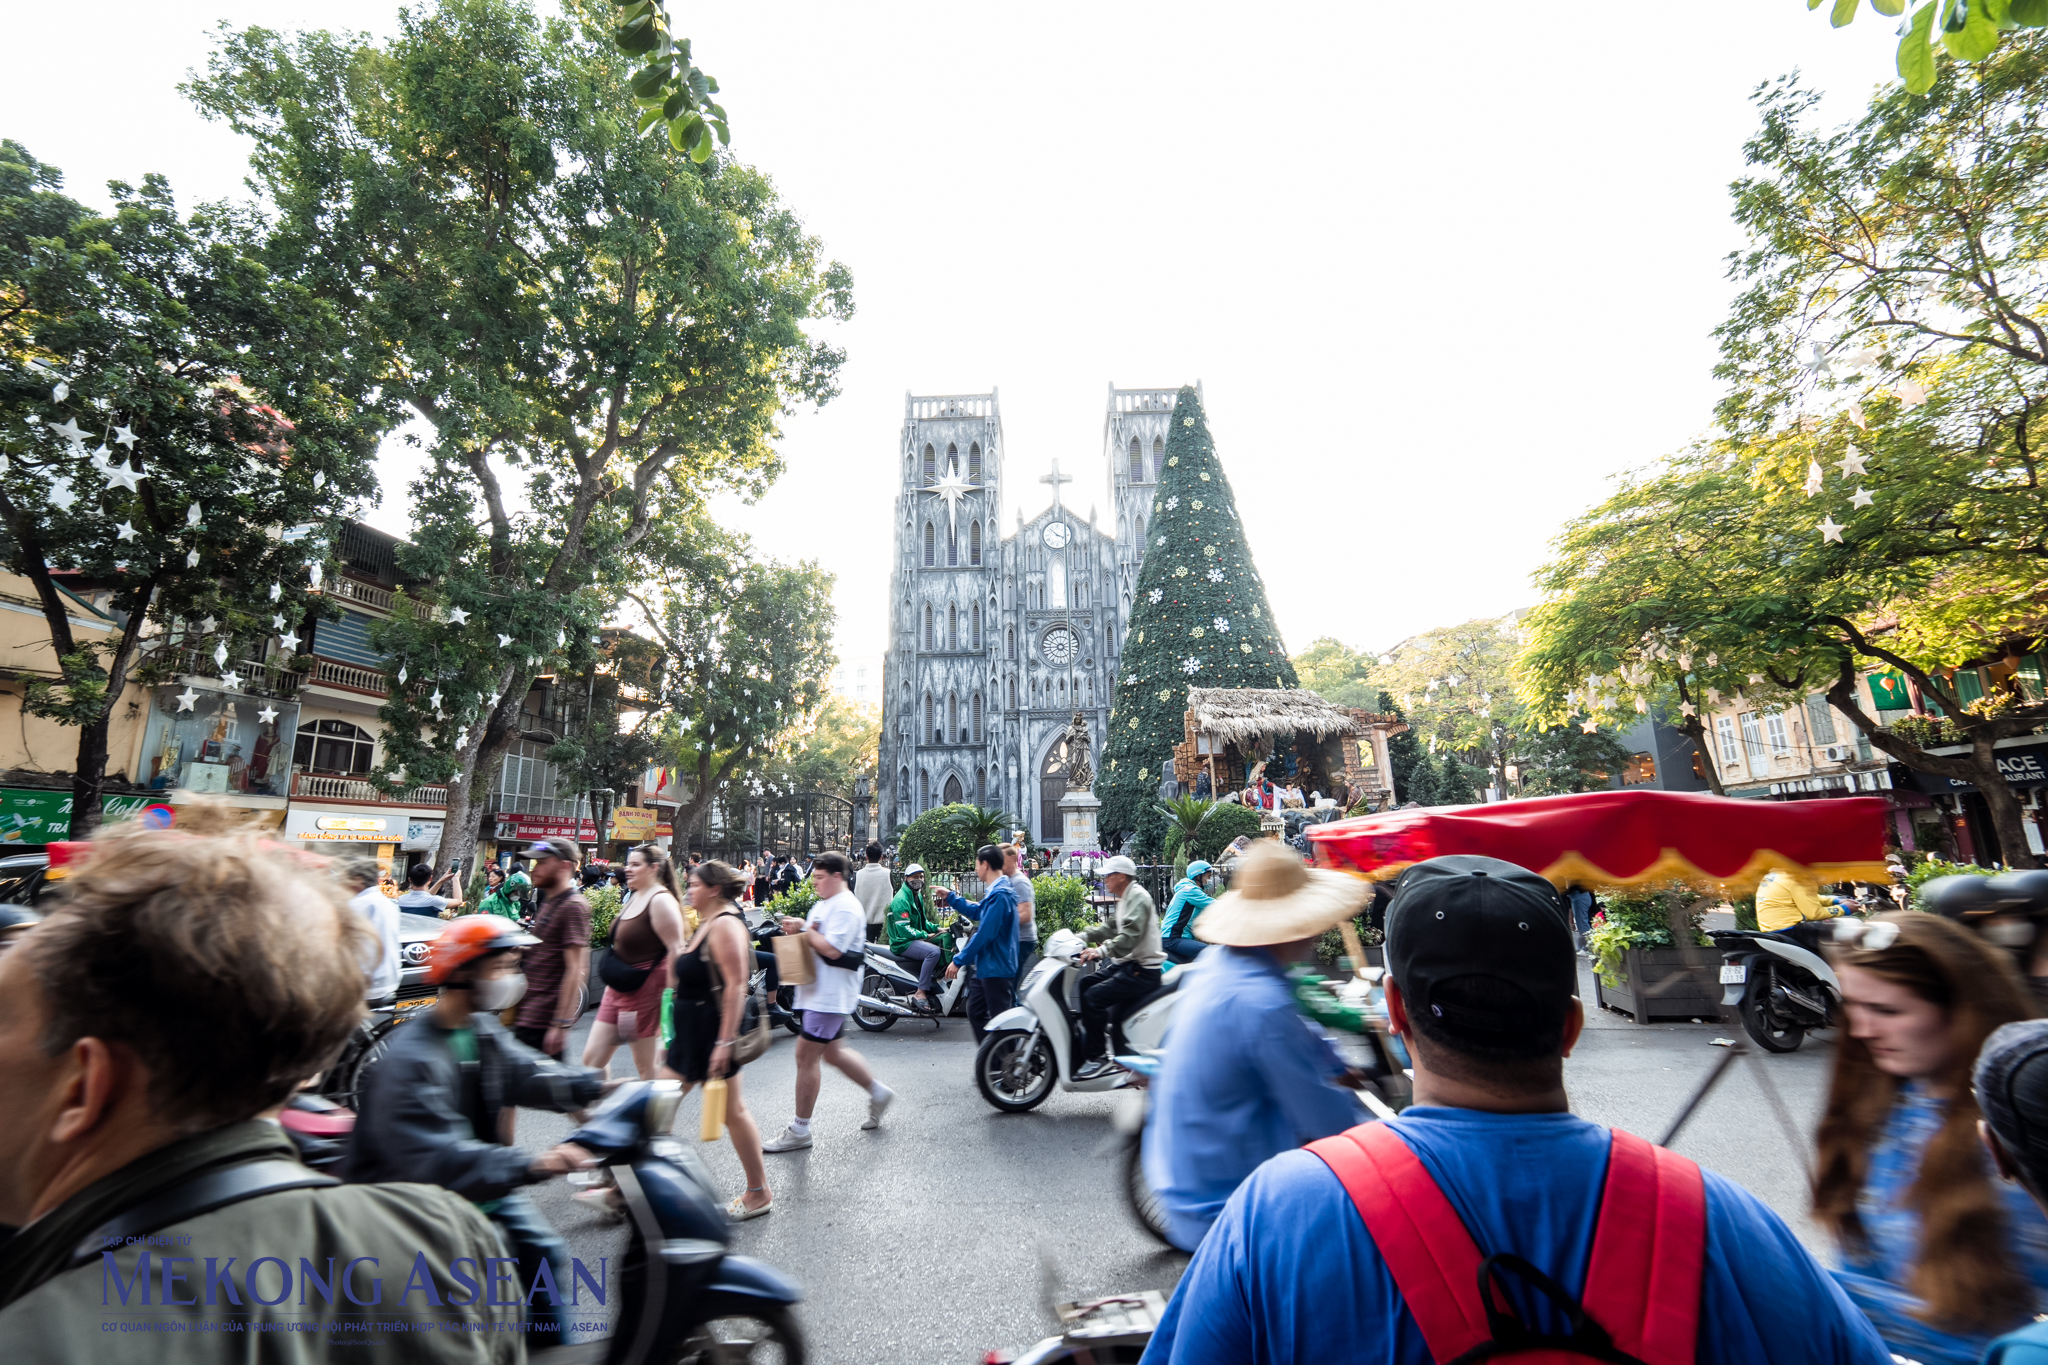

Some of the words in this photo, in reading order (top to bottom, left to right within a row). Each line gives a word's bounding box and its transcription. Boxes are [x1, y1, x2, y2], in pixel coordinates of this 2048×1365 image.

[1996, 755, 2042, 773] ACE
[2004, 771, 2047, 782] AURANT
[528, 827, 544, 835] CHANH
[547, 827, 558, 835] CAFÉ
